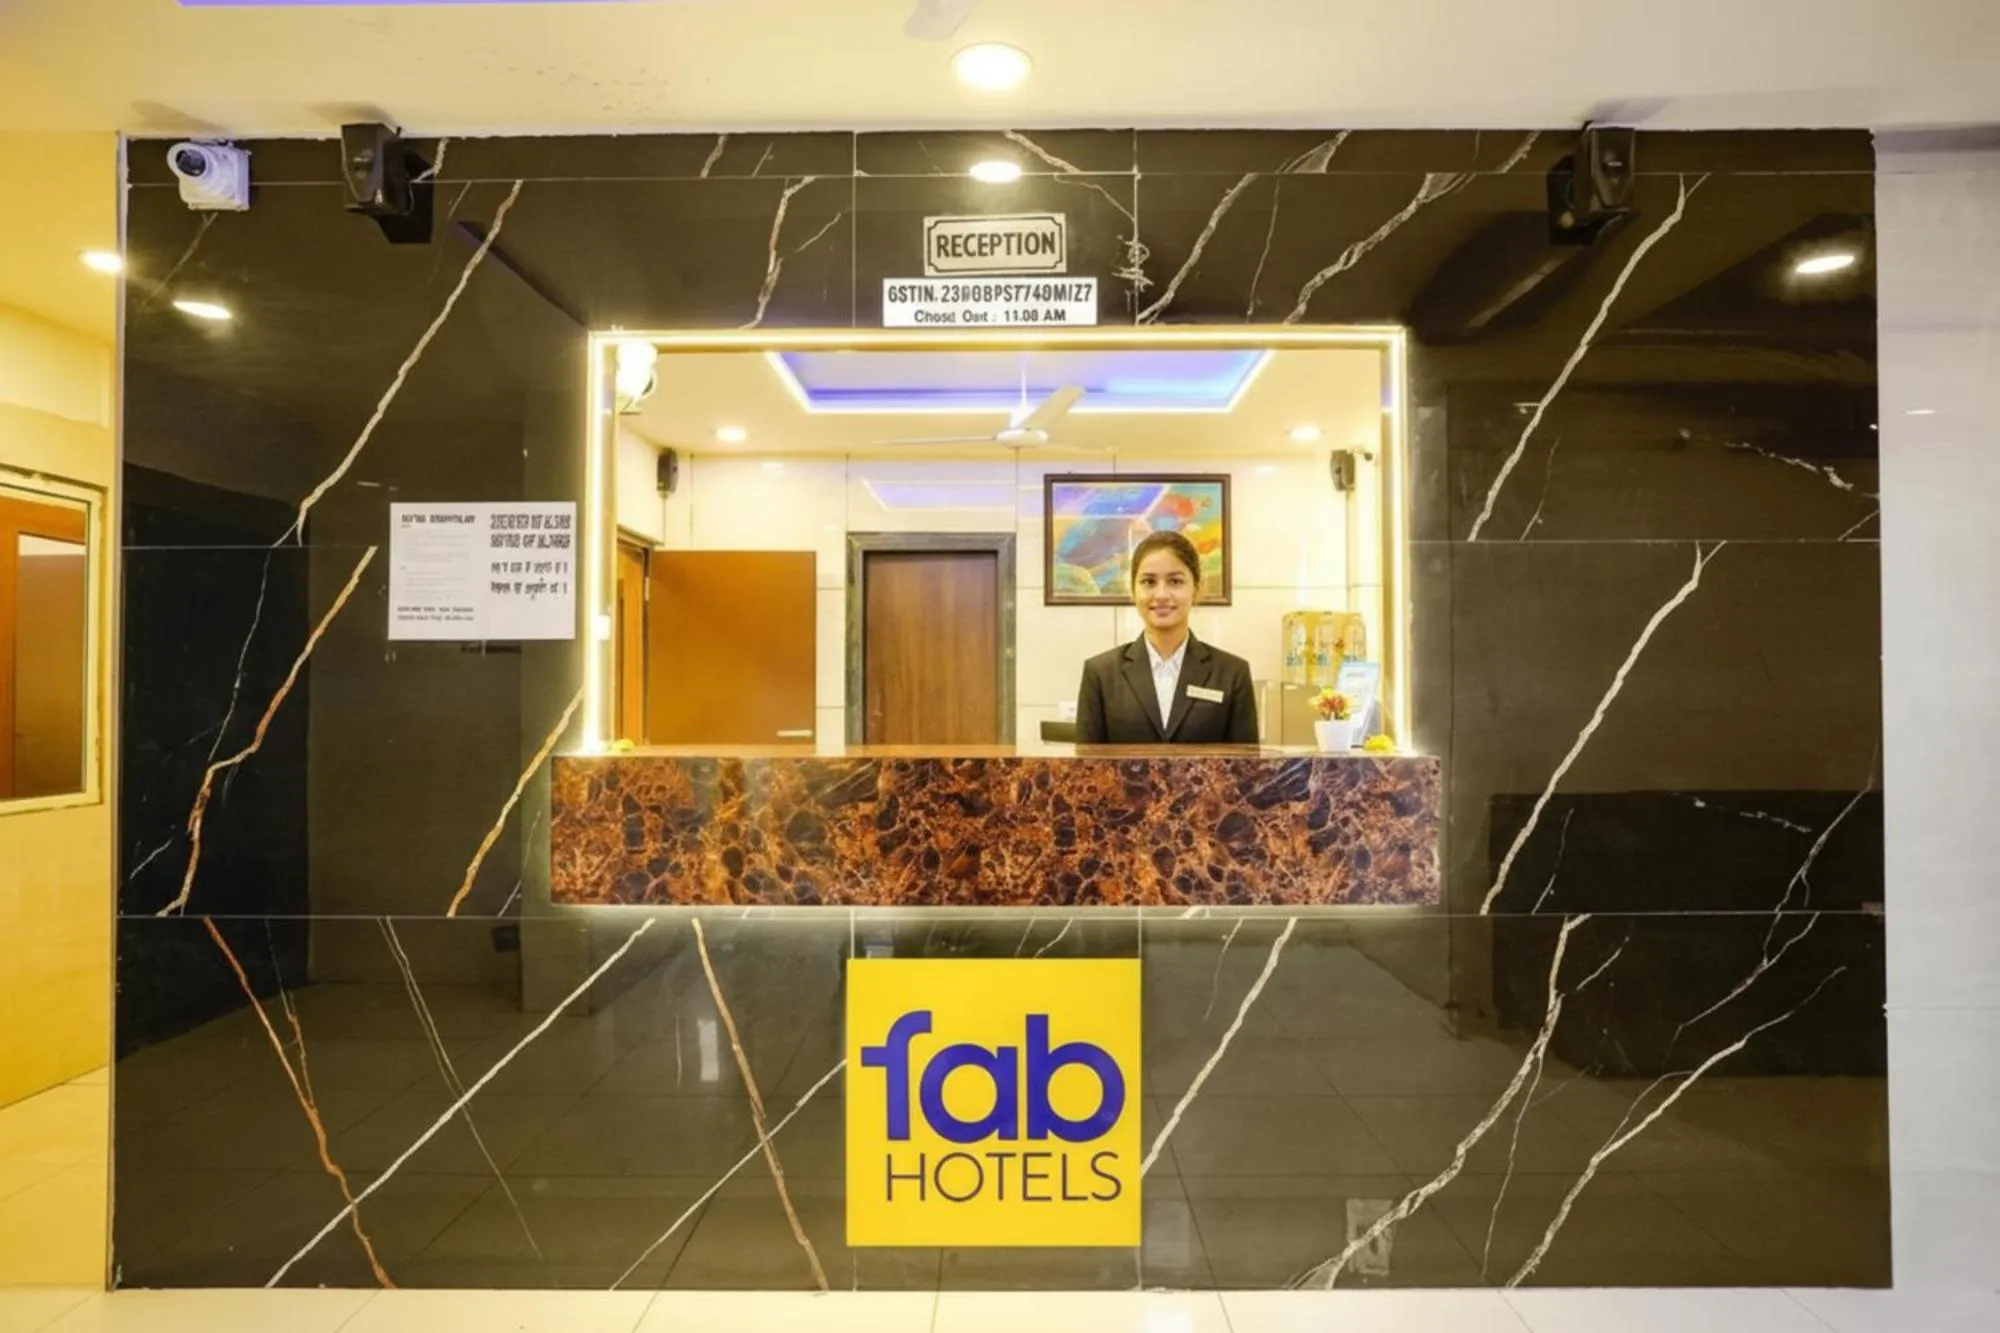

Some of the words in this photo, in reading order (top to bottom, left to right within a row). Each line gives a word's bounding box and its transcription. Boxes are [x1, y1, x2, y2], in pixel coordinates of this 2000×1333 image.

[936, 231, 1056, 258] RECEPTION
[1043, 309, 1066, 321] AM
[861, 1010, 1125, 1143] fab
[886, 1151, 1122, 1202] HOTELS
